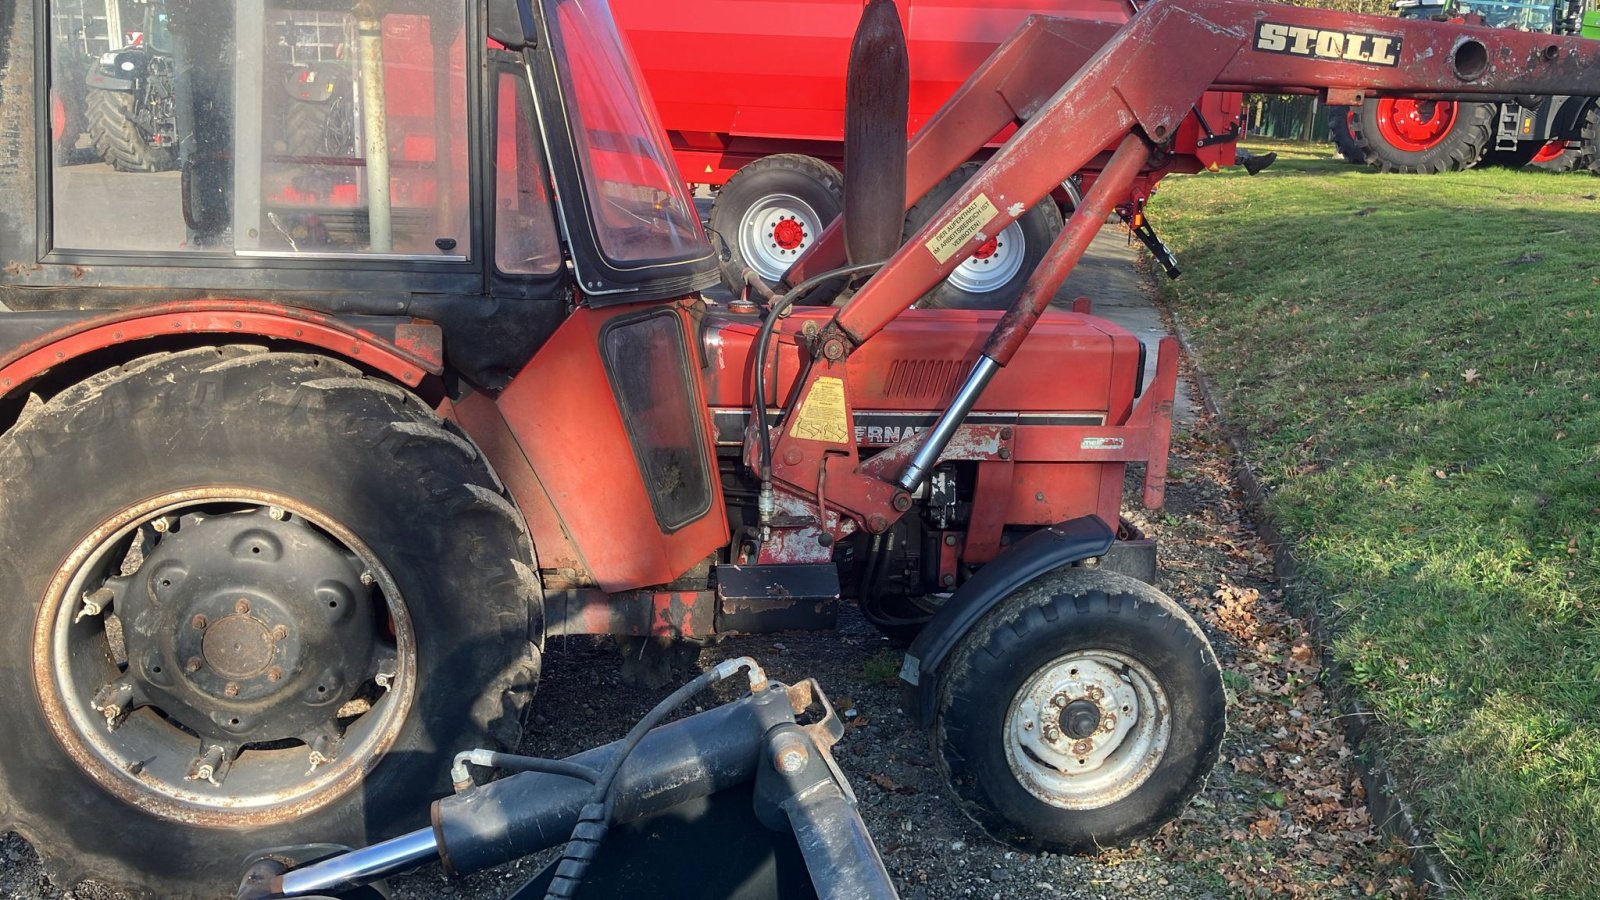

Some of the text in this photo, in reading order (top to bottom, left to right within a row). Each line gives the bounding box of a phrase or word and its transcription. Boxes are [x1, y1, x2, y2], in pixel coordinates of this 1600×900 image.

[1258, 23, 1395, 65] STOLL
[932, 201, 990, 255] IM ARBEITSBEREICH IST
[936, 202, 978, 242] DER AUFENTHALT
[952, 220, 981, 247] VERBOTEN!
